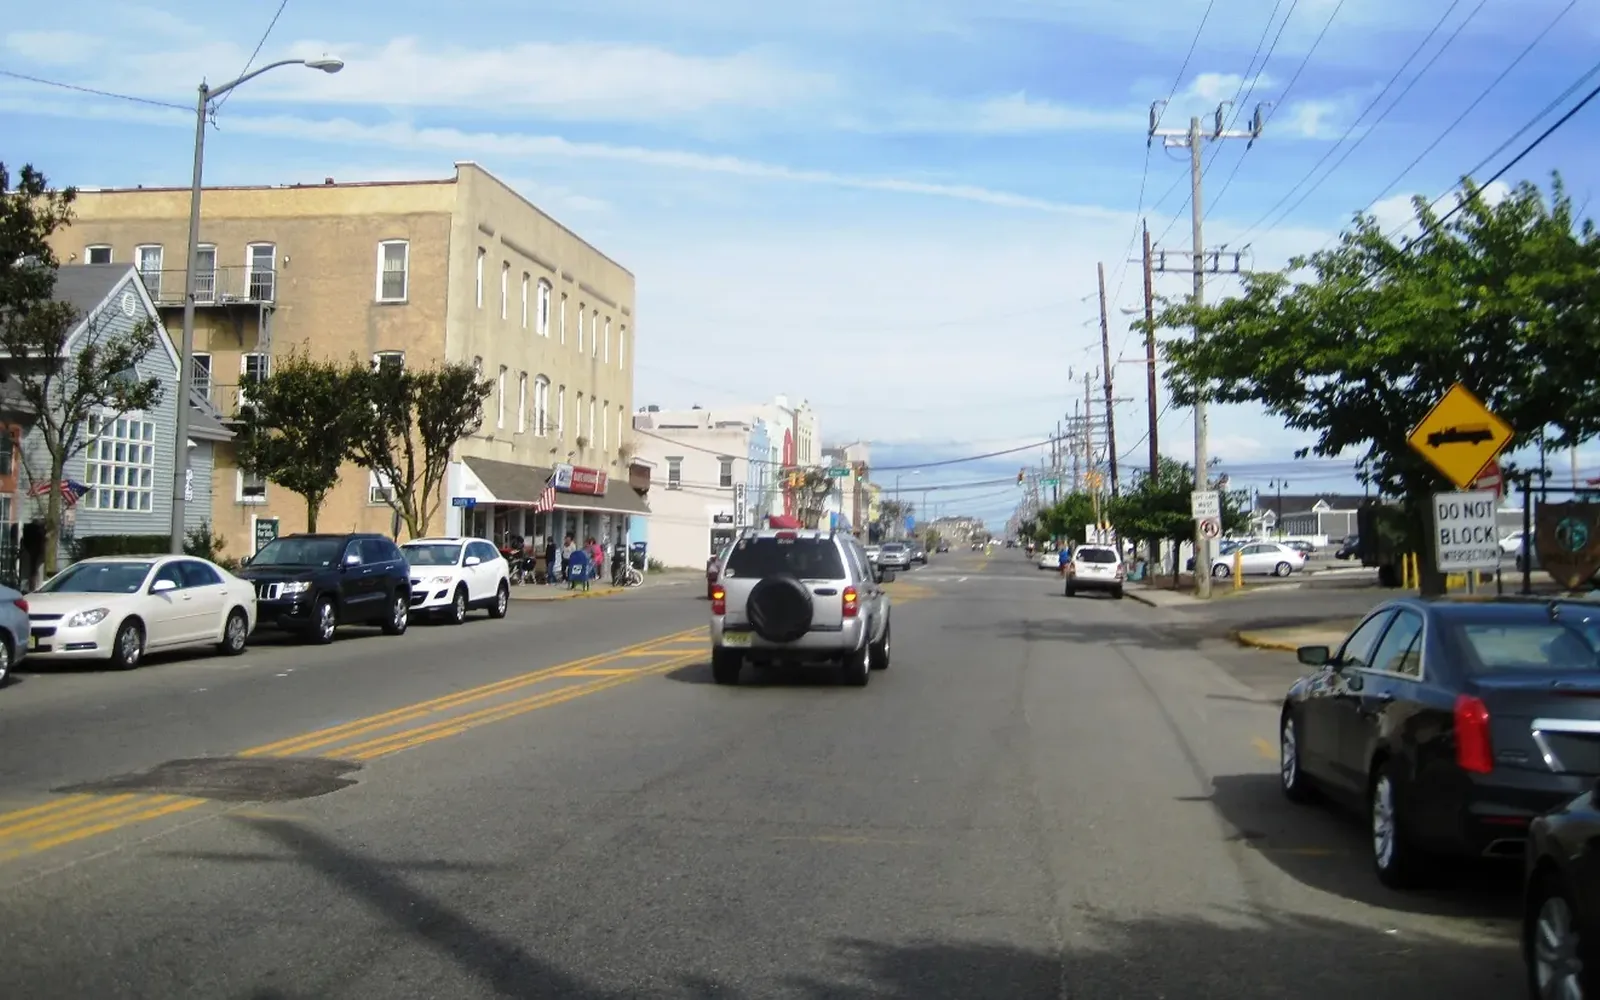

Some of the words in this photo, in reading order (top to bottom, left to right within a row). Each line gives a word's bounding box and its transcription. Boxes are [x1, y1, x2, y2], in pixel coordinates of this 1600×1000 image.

[1439, 502, 1460, 520] DO
[1463, 500, 1494, 519] NOT
[1440, 525, 1495, 545] BLOCK
